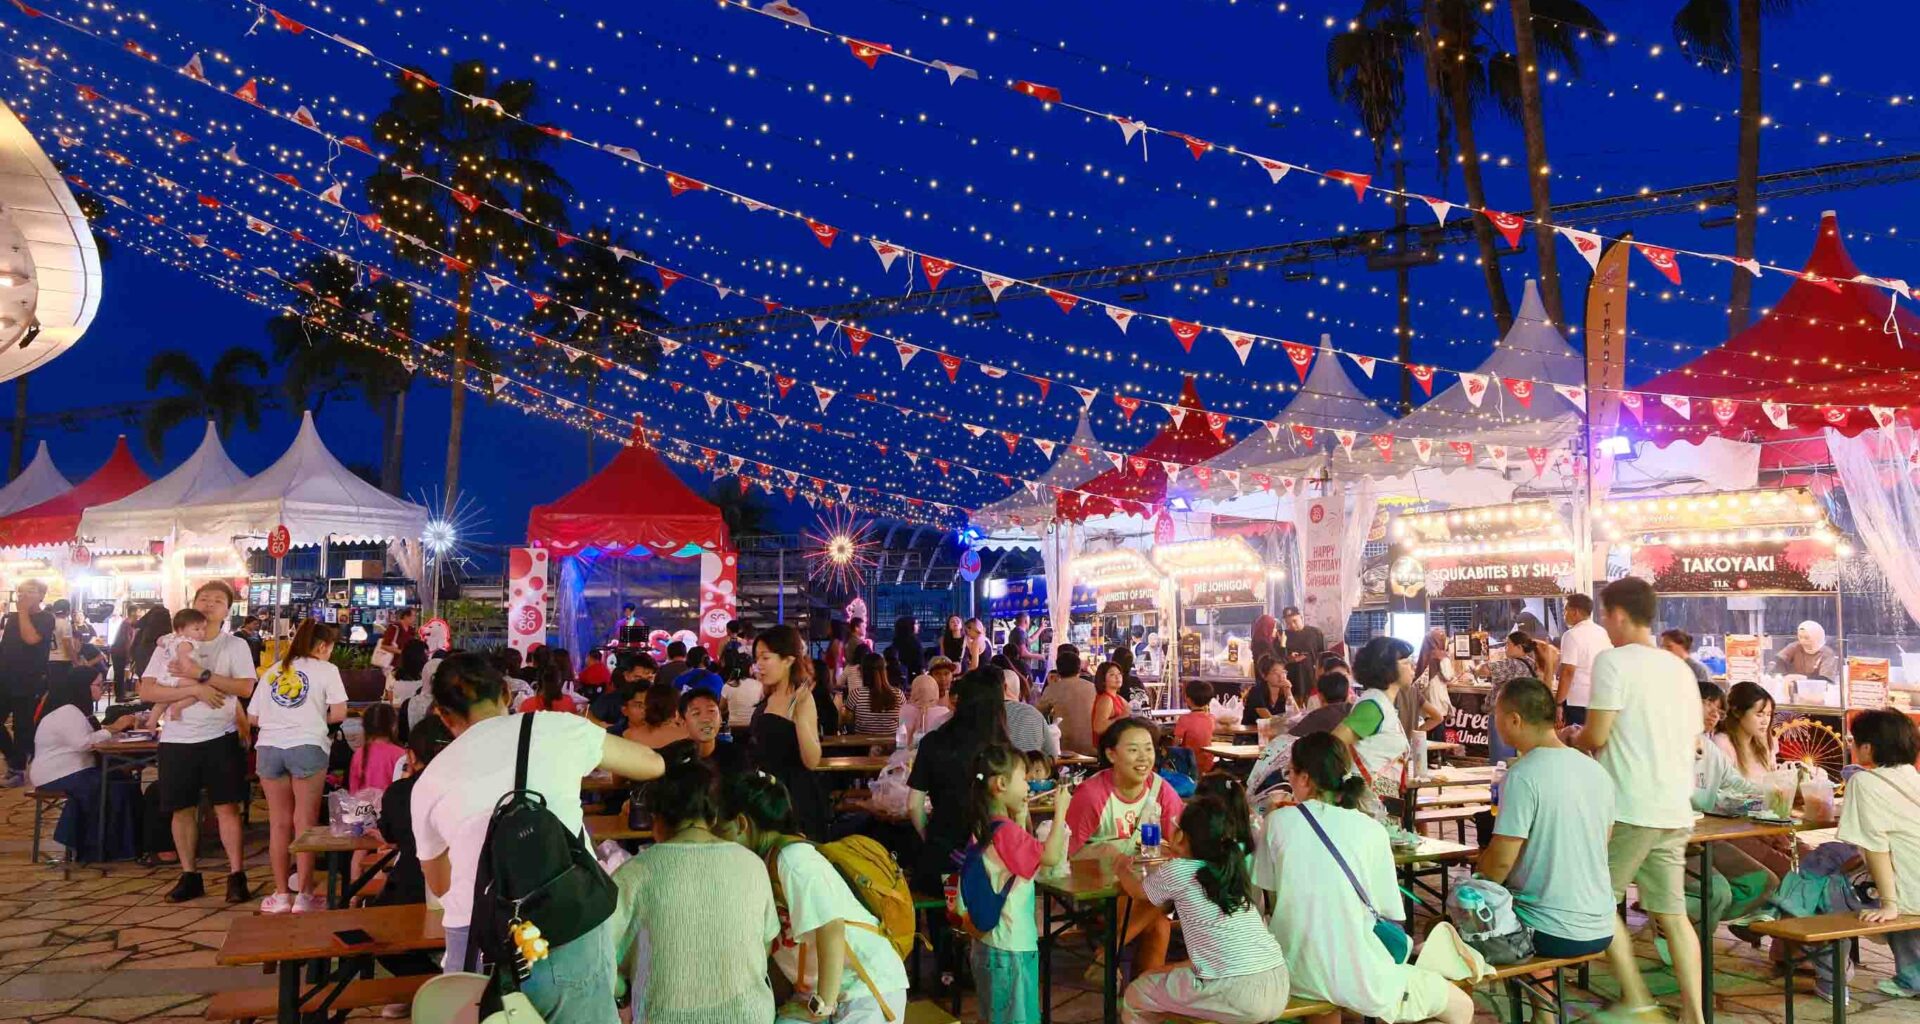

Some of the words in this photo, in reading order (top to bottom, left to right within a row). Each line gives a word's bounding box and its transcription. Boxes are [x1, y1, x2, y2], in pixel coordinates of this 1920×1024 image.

[272, 541, 286, 553] 60
[1313, 545, 1335, 558] HAPPY
[1681, 556, 1775, 573] TAKOYAKI
[1432, 566, 1507, 581] SQUKABITES
[1511, 564, 1528, 578] BY
[1532, 562, 1569, 578] SHAZ
[1193, 581, 1207, 593] THE
[1103, 591, 1129, 602] MINISTRY
[1130, 589, 1138, 600] OF
